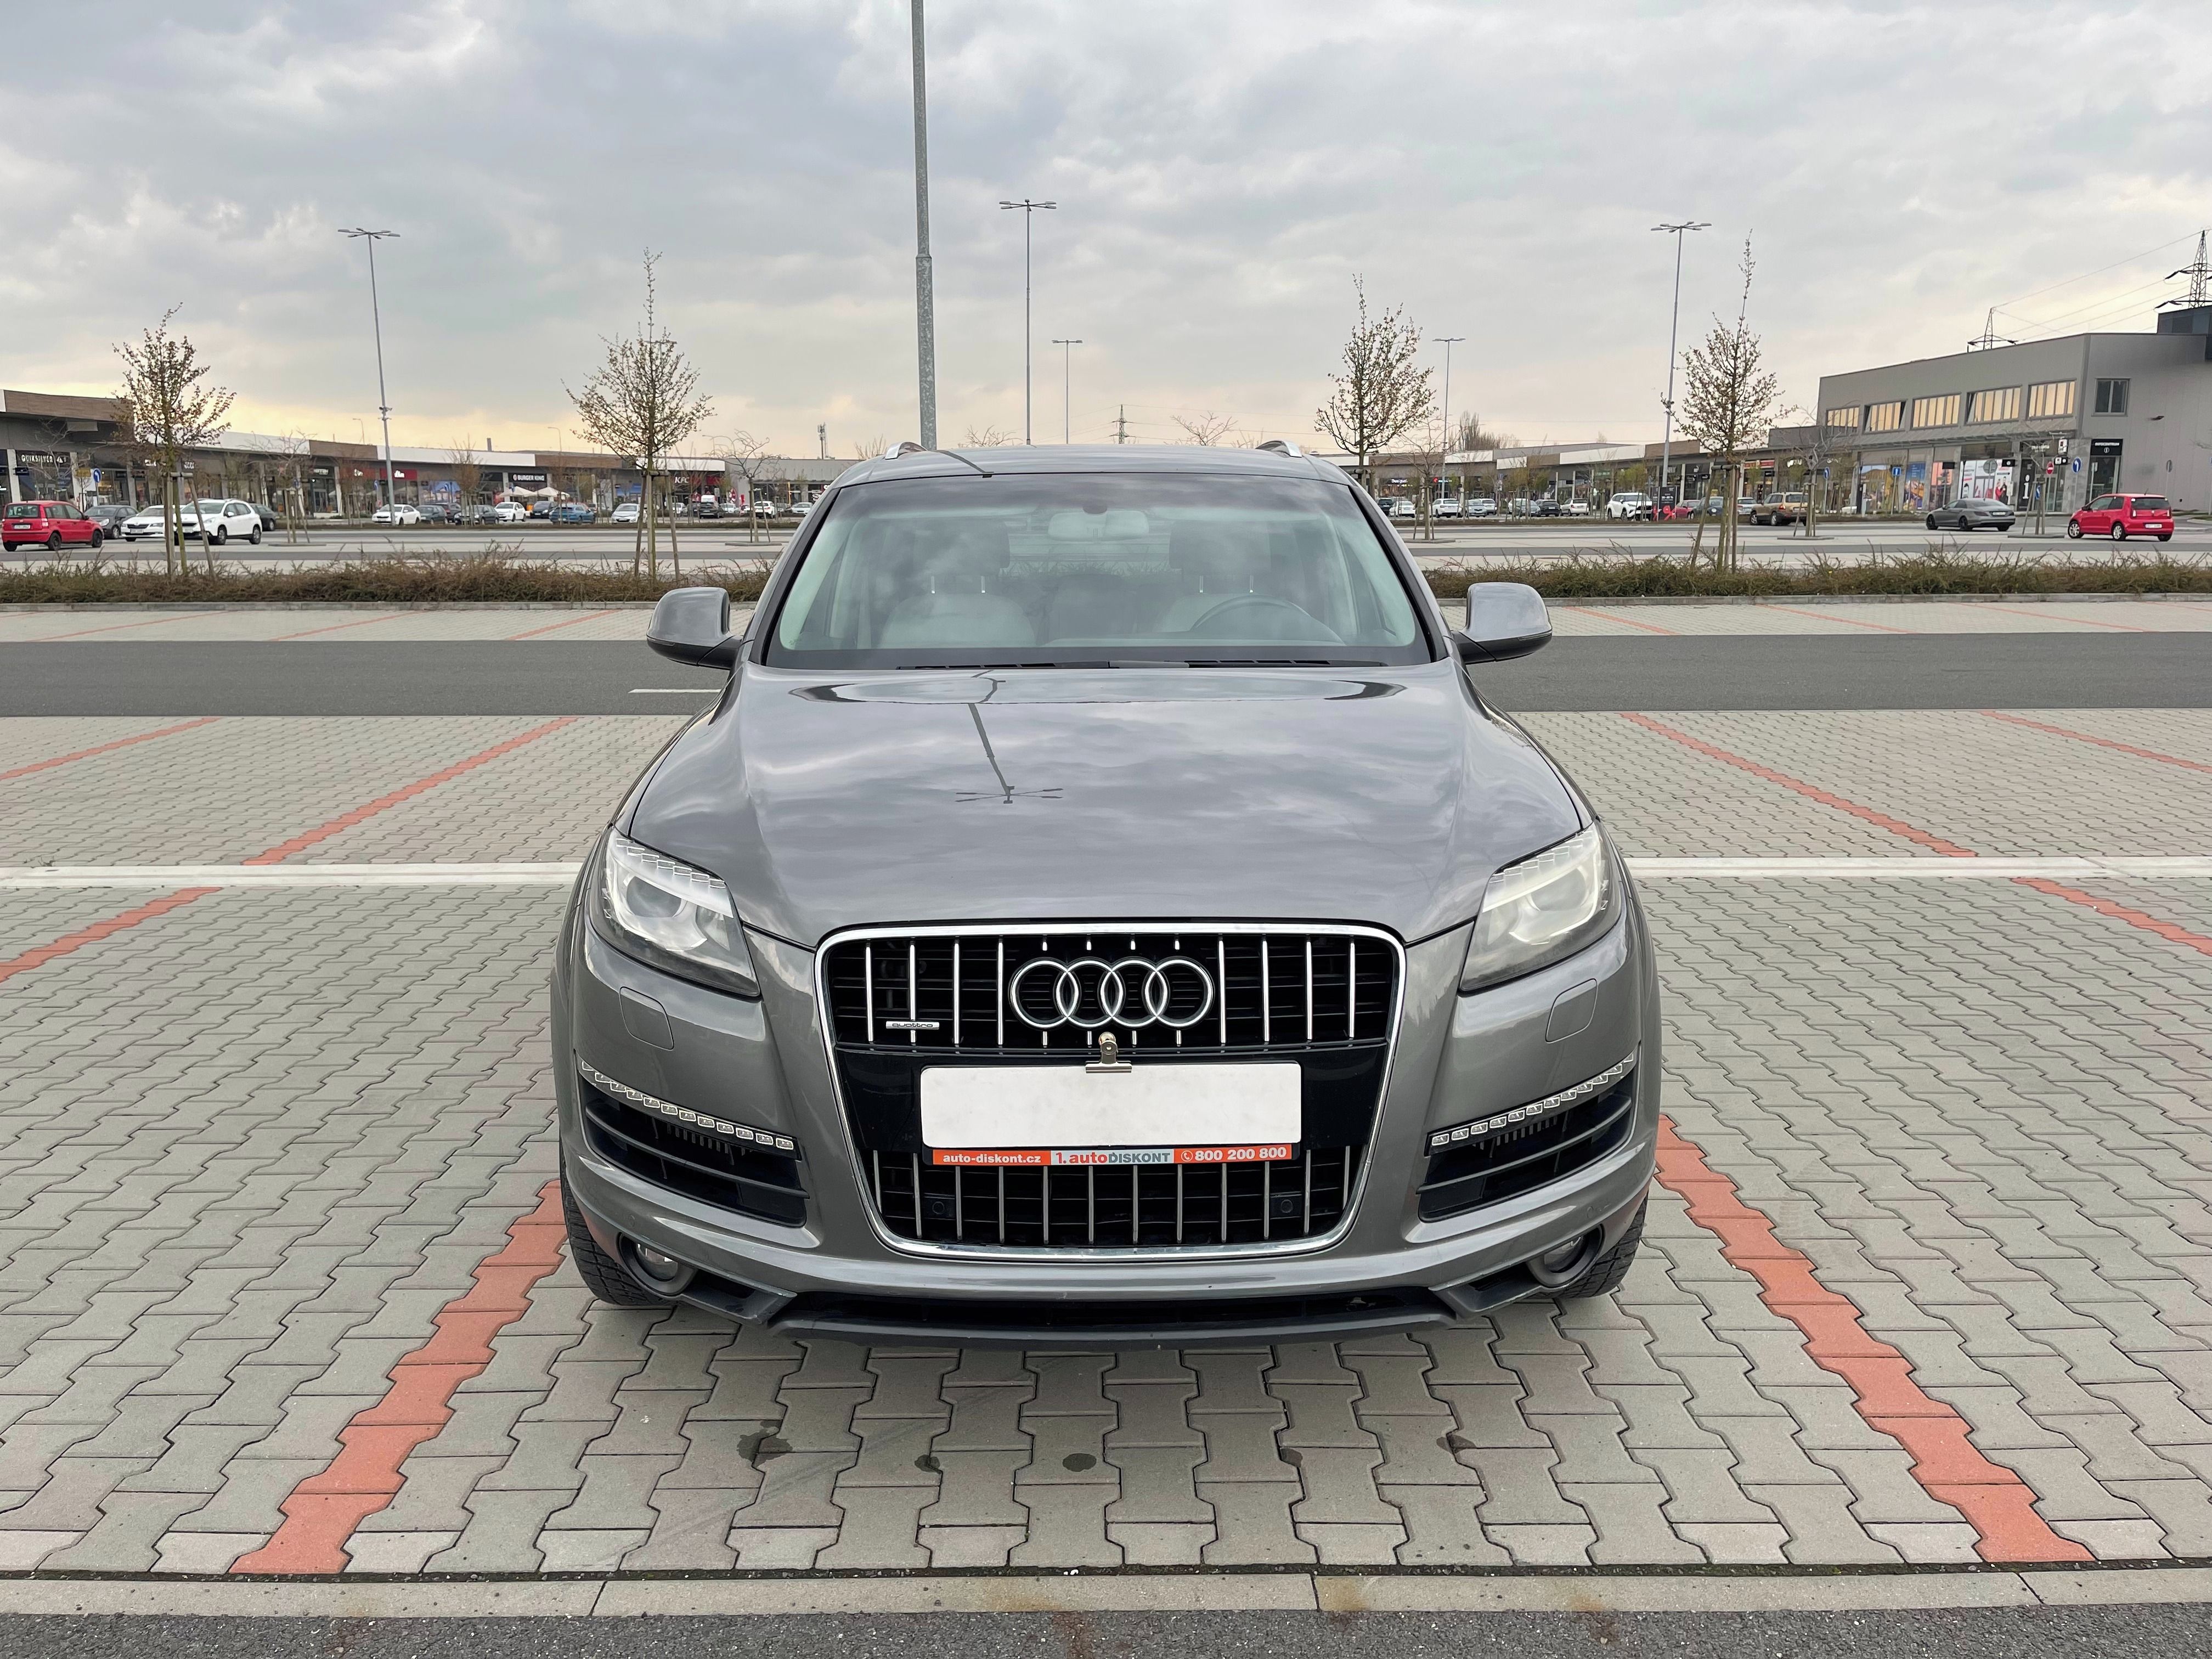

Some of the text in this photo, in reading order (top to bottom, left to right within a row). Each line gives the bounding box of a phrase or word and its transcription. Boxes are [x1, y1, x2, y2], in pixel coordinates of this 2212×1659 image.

[21, 454, 53, 463] QUIKSILVER
[943, 1153, 1041, 1164] auto-diskont.cz
[1194, 1147, 1287, 1161] 800 200 800
